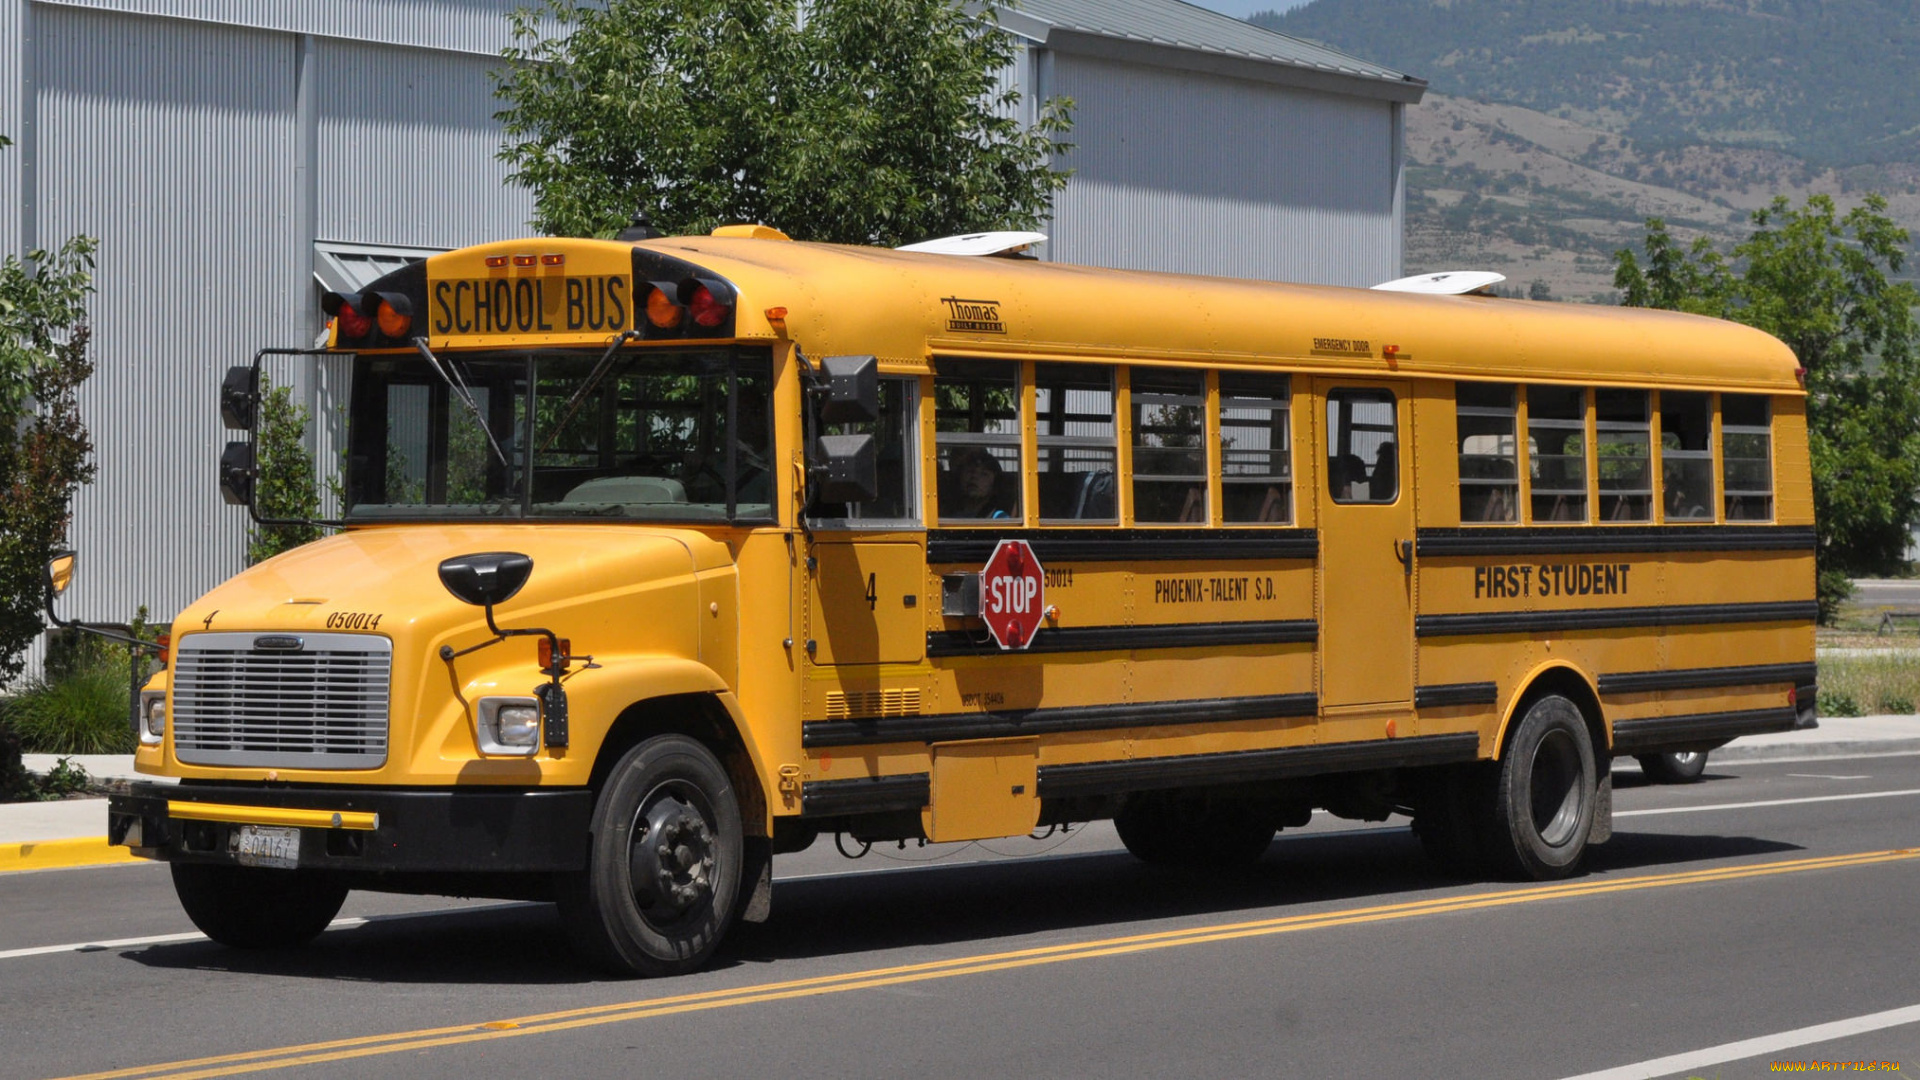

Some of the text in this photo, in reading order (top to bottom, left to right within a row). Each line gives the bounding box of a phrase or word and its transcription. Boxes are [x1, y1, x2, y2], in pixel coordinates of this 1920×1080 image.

[435, 276, 625, 333] SCHOOL BUS
[940, 296, 1001, 321] Thomas
[1313, 338, 1370, 352] EMERGENCY DOOR
[866, 572, 877, 610] 4
[1155, 577, 1277, 603] PHOENIX-TALENT S.D.
[1475, 564, 1630, 598] FIRST STUDENT
[991, 576, 1037, 613] STOP
[203, 610, 220, 630] 4
[326, 612, 383, 630] 050014
